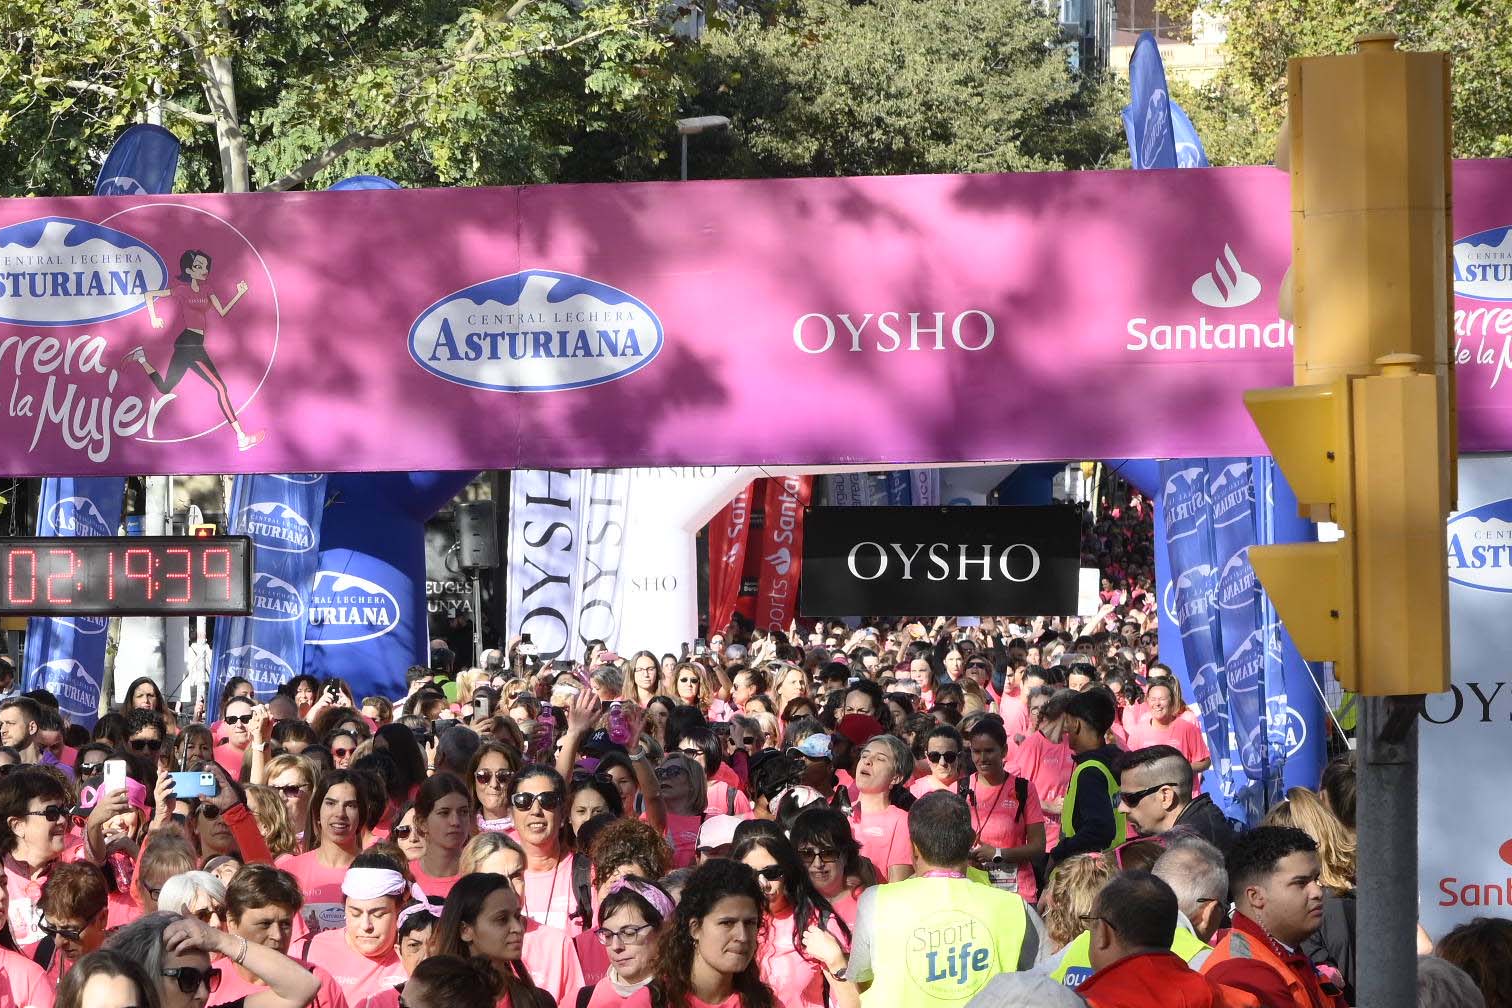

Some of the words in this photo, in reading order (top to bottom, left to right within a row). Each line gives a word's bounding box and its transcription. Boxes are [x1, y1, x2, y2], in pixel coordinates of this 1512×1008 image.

[70, 254, 143, 265] LECHERA
[428, 317, 644, 361] ASTURIANA
[467, 312, 546, 325] CENTRAL
[554, 311, 635, 323] LECHERA
[793, 310, 996, 354] OYSHO
[9, 379, 34, 417] la
[28, 368, 178, 463] Mujer
[236, 511, 309, 547] ASTURIANA
[7, 549, 232, 603] 02:19:39
[846, 541, 1042, 583] OYSHO
[631, 576, 678, 592] SHO
[309, 607, 391, 626] URIANA
[768, 579, 788, 633] ports
[913, 919, 977, 953] Sport
[925, 942, 990, 985] Life
